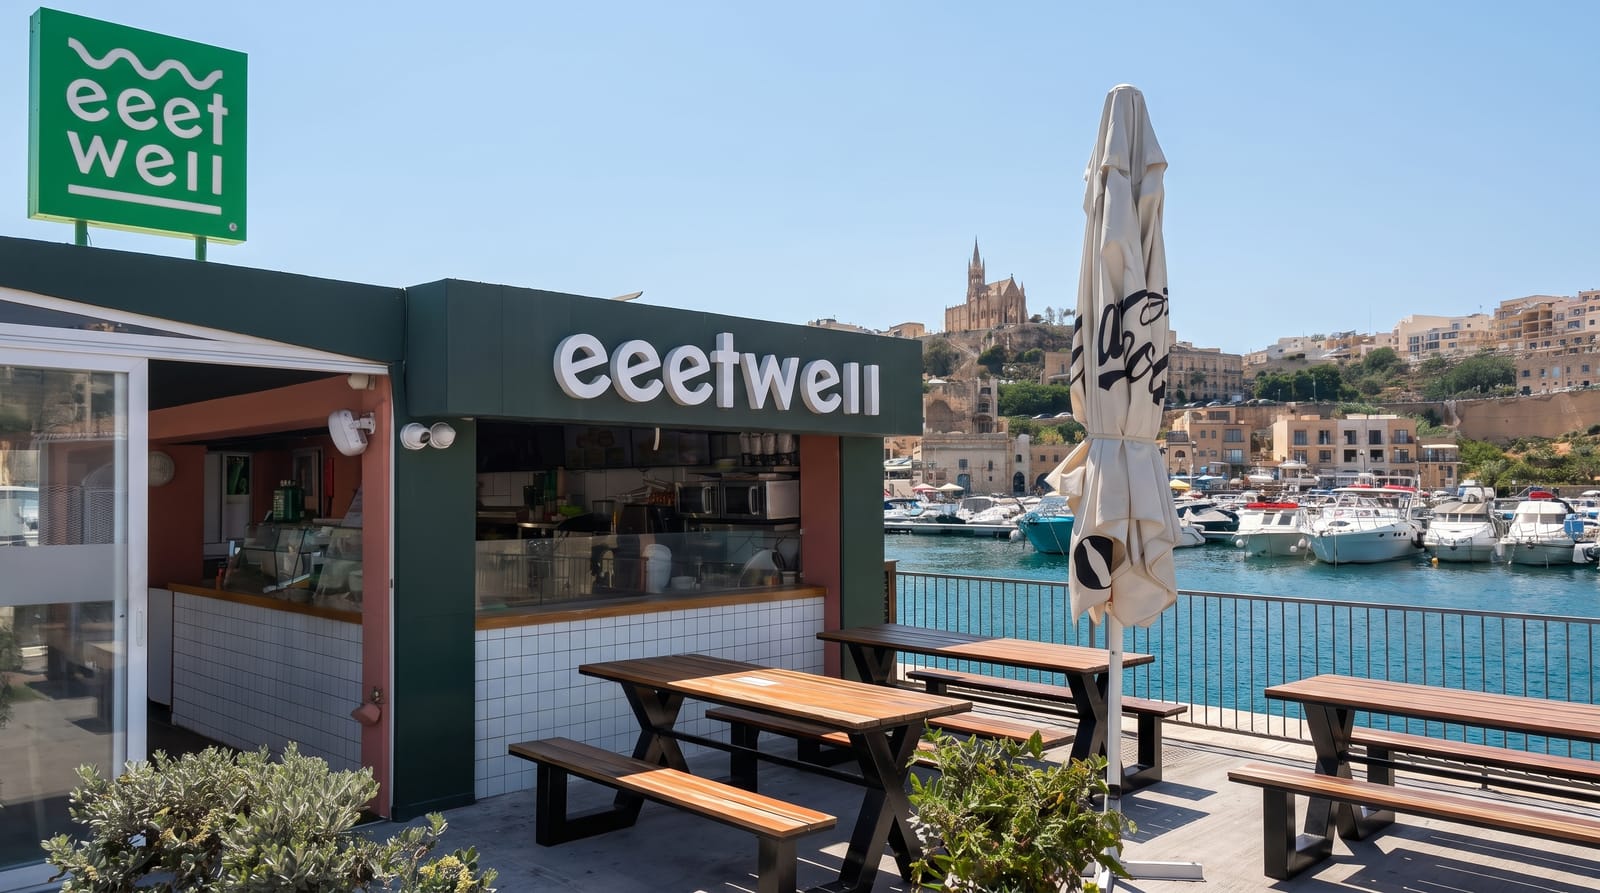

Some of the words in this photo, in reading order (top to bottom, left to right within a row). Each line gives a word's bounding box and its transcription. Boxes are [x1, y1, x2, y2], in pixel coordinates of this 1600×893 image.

[66, 78, 228, 146] eeet
[66, 130, 222, 195] well
[553, 331, 880, 416] eeetwell
